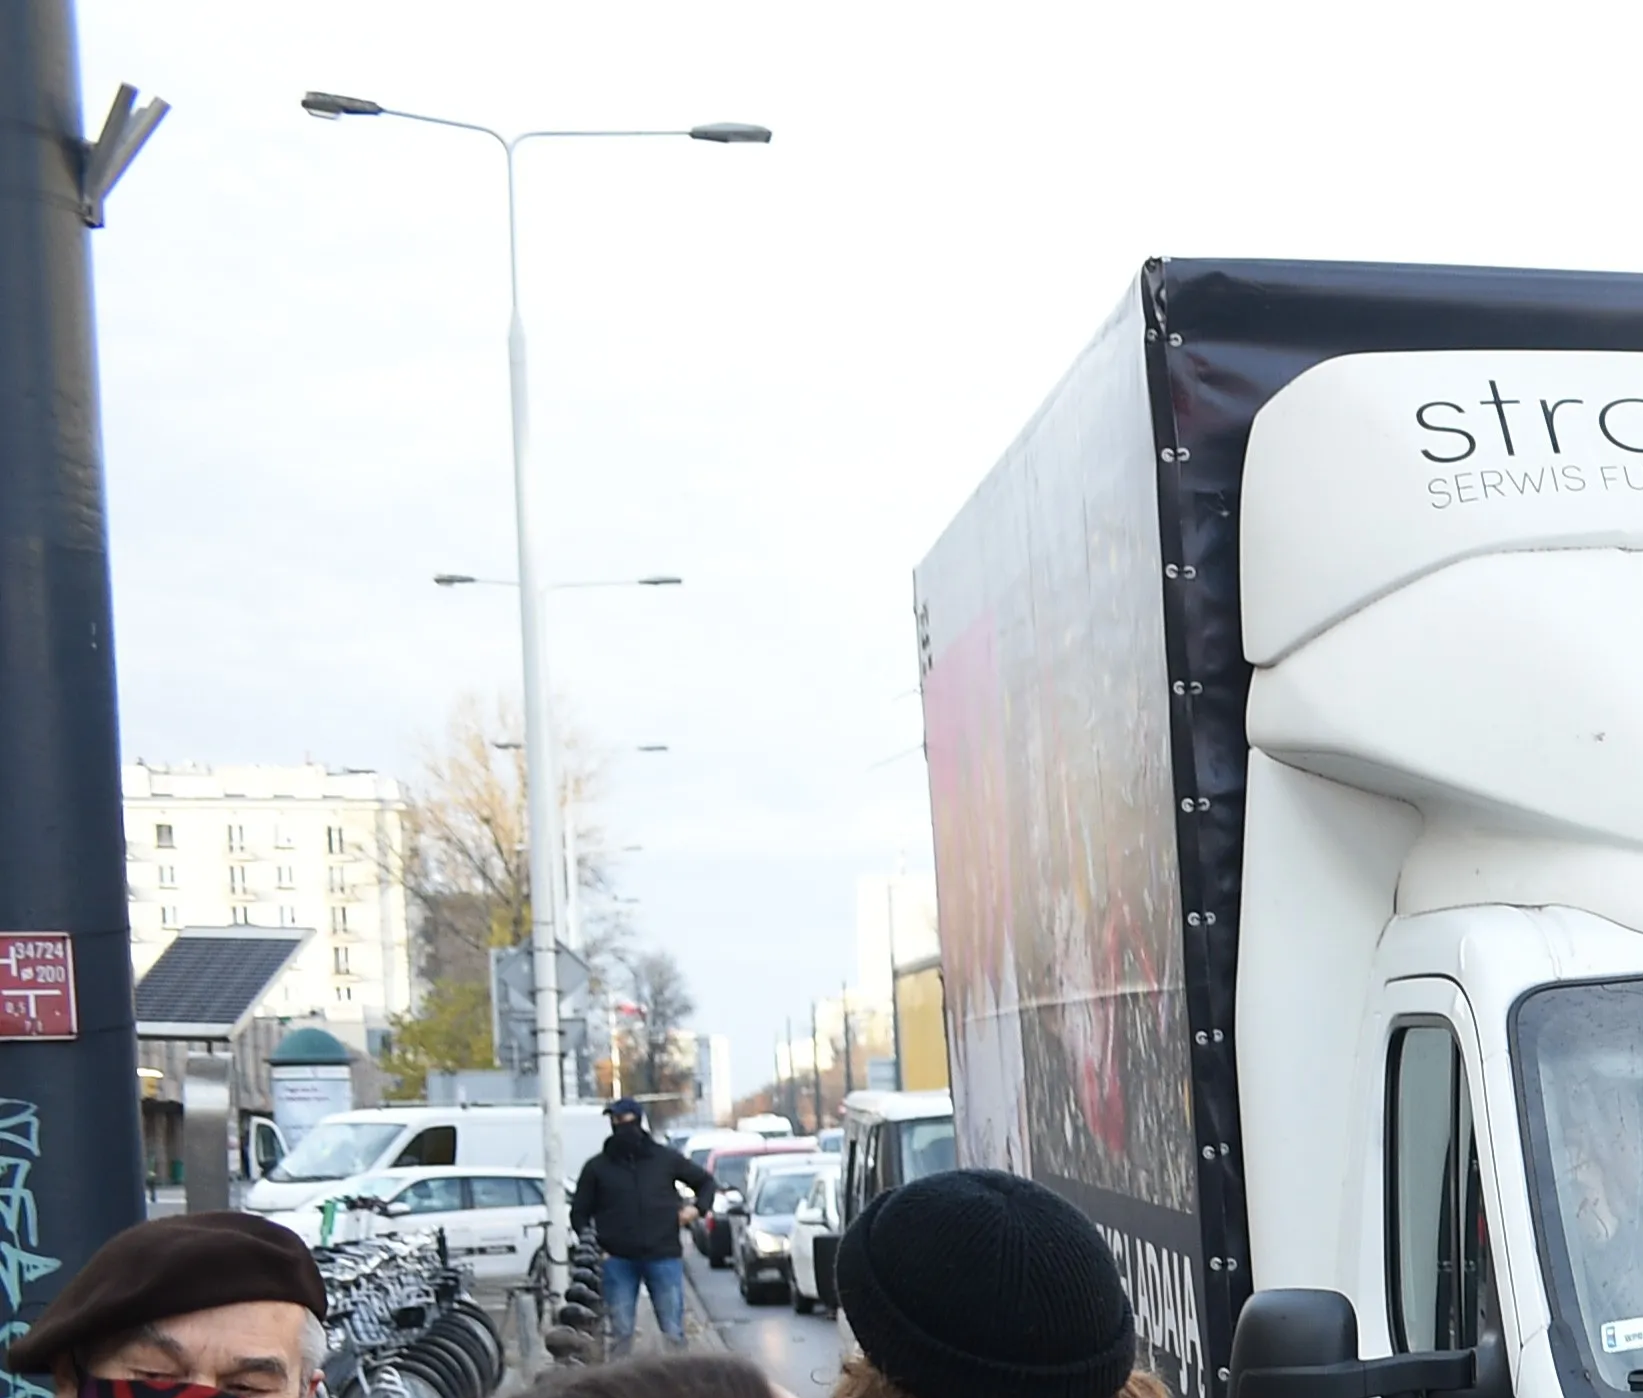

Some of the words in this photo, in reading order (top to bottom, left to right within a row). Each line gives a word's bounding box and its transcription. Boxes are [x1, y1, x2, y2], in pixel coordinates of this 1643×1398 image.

[1427, 465, 1587, 509] SERWIS
[14, 941, 65, 960] 34724
[35, 965, 66, 983] 200
